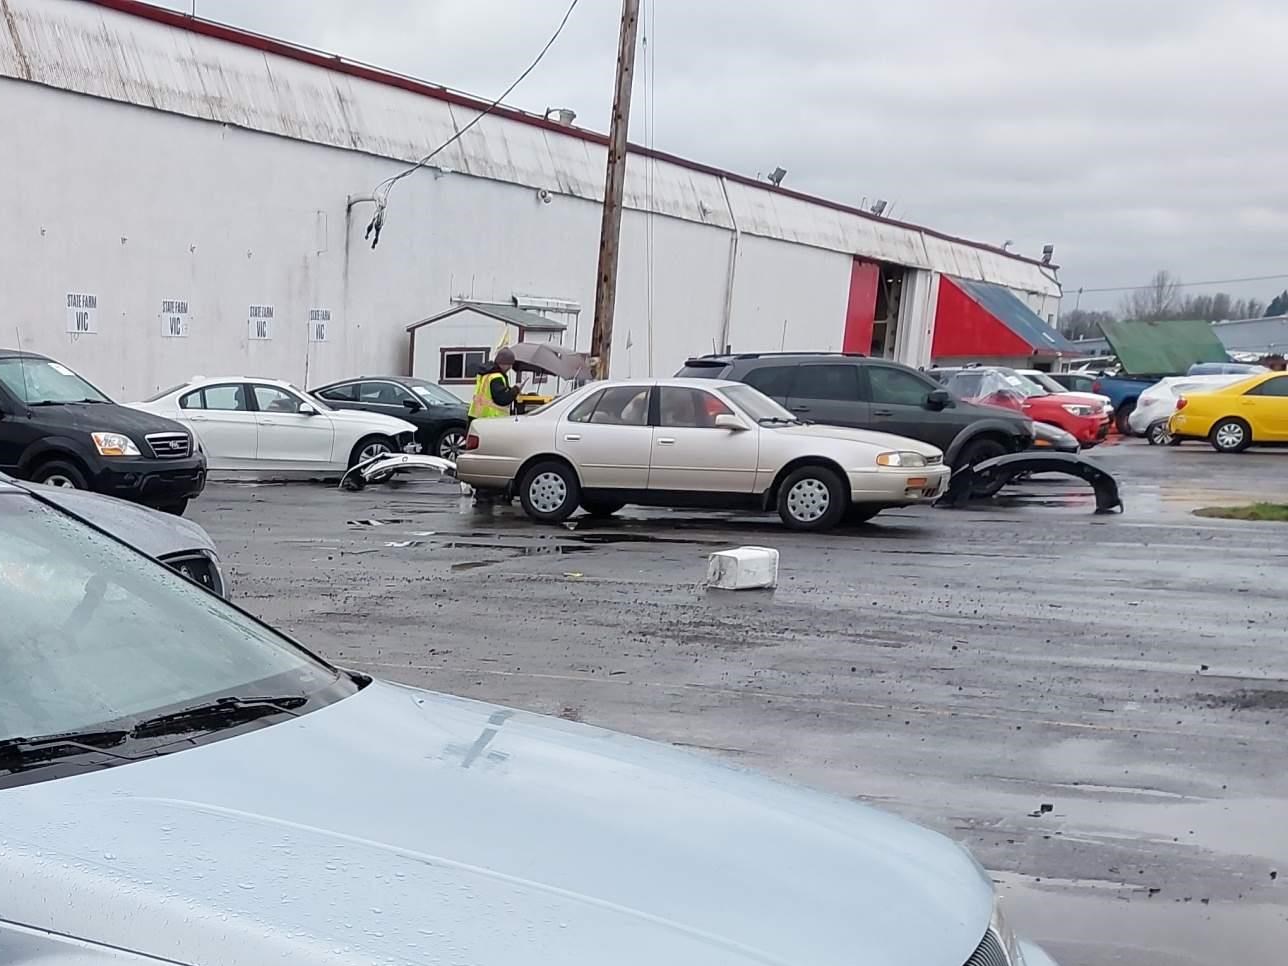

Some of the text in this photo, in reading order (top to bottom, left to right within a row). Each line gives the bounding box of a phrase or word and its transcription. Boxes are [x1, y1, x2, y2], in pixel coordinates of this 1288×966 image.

[67, 294, 97, 309] STATE FARM
[162, 300, 188, 314] STATE FARM
[249, 306, 274, 318] STATE FARM
[75, 311, 89, 331] VIC
[169, 316, 181, 335] VIC
[256, 321, 267, 338] VIC
